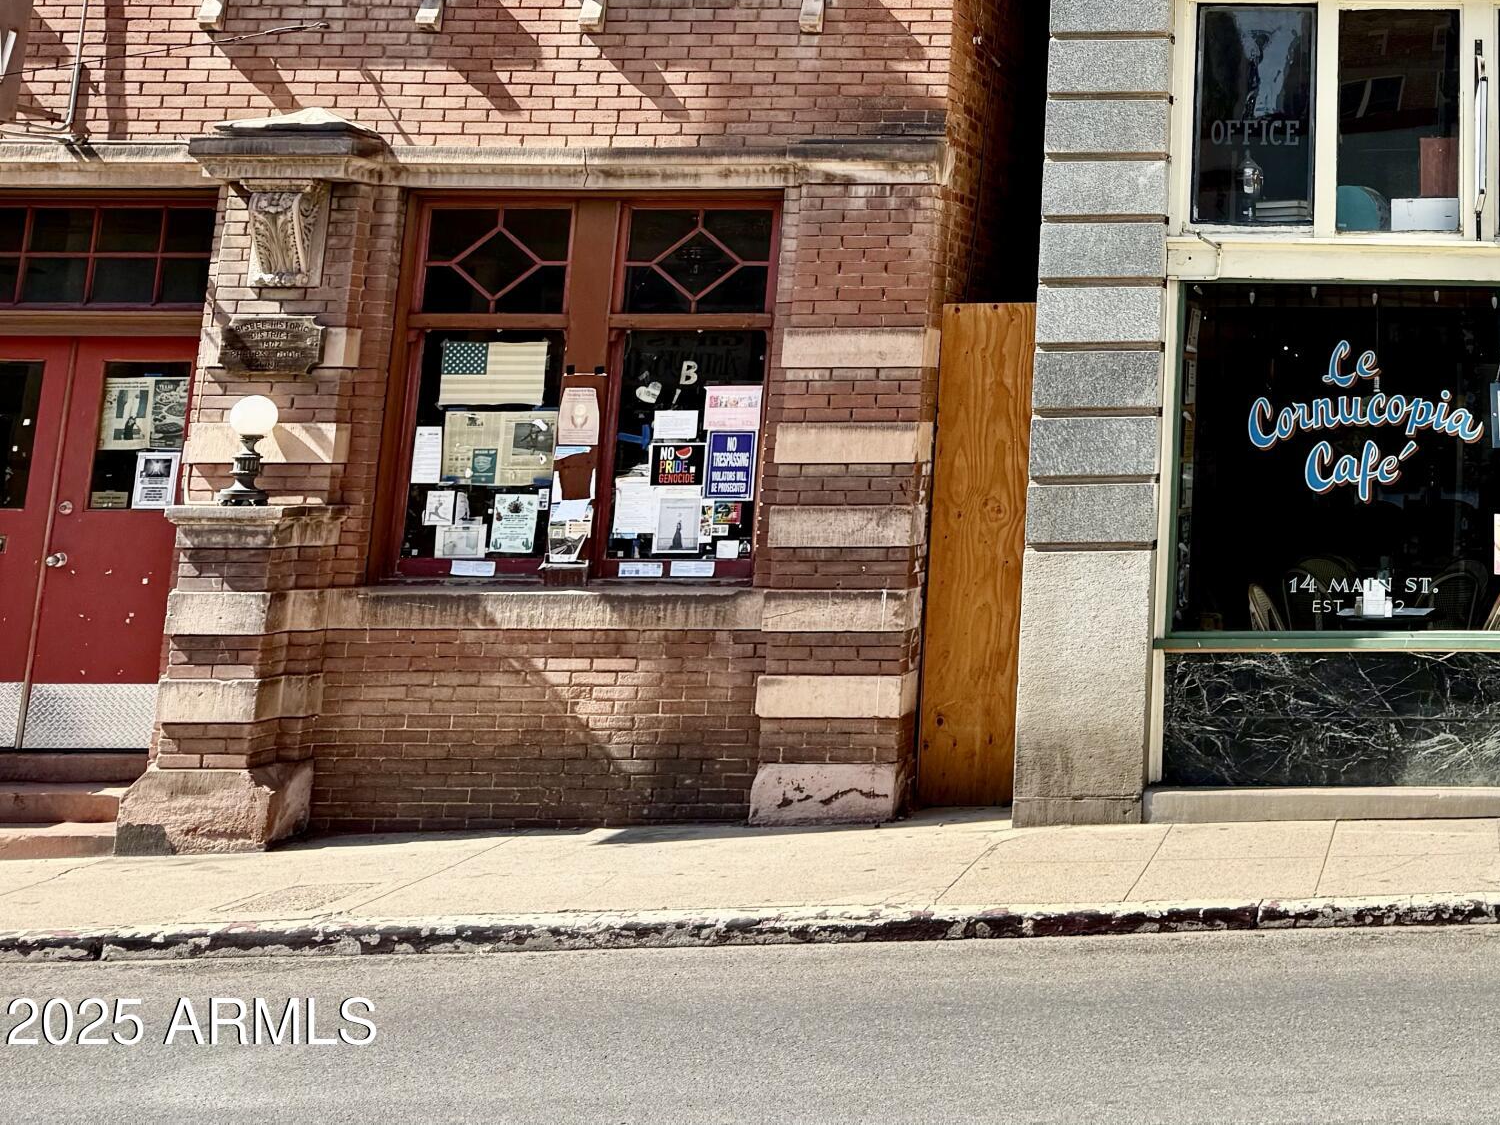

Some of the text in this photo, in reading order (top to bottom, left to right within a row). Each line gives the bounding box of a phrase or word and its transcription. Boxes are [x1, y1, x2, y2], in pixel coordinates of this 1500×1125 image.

[1211, 119, 1300, 145] OFFICE
[1322, 340, 1381, 387] Le
[1248, 390, 1484, 448] Cornucopia
[727, 437, 737, 451] NO
[660, 447, 675, 460] NO
[712, 452, 749, 467] TRESPASSING
[659, 460, 688, 473] PRIDE
[1305, 440, 1419, 503] Café
[658, 474, 695, 483] GENOCIDE
[711, 471, 746, 481] VIOLATORS WILL
[711, 483, 746, 493] BE PROSECUTED
[1288, 574, 1439, 594] 14 MAIN ST.
